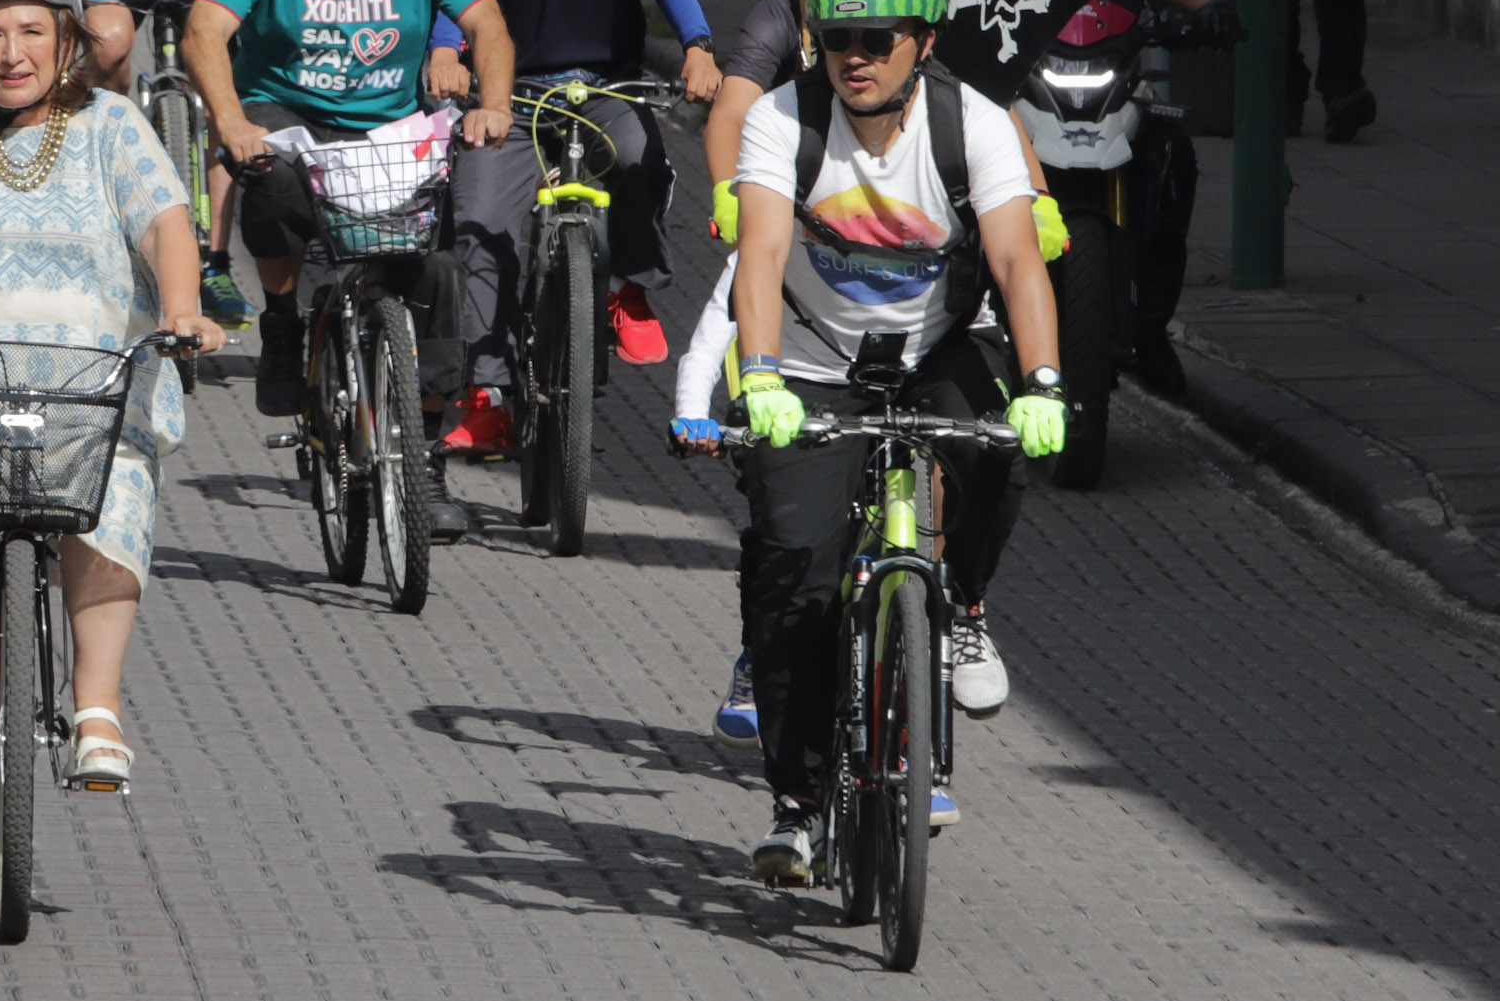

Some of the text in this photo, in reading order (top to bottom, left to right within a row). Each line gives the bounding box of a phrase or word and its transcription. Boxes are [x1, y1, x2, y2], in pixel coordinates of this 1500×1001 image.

[302, 28, 346, 44] SAL
[300, 48, 354, 73] VA!
[299, 69, 346, 90] NOS
[357, 68, 404, 90] MX!
